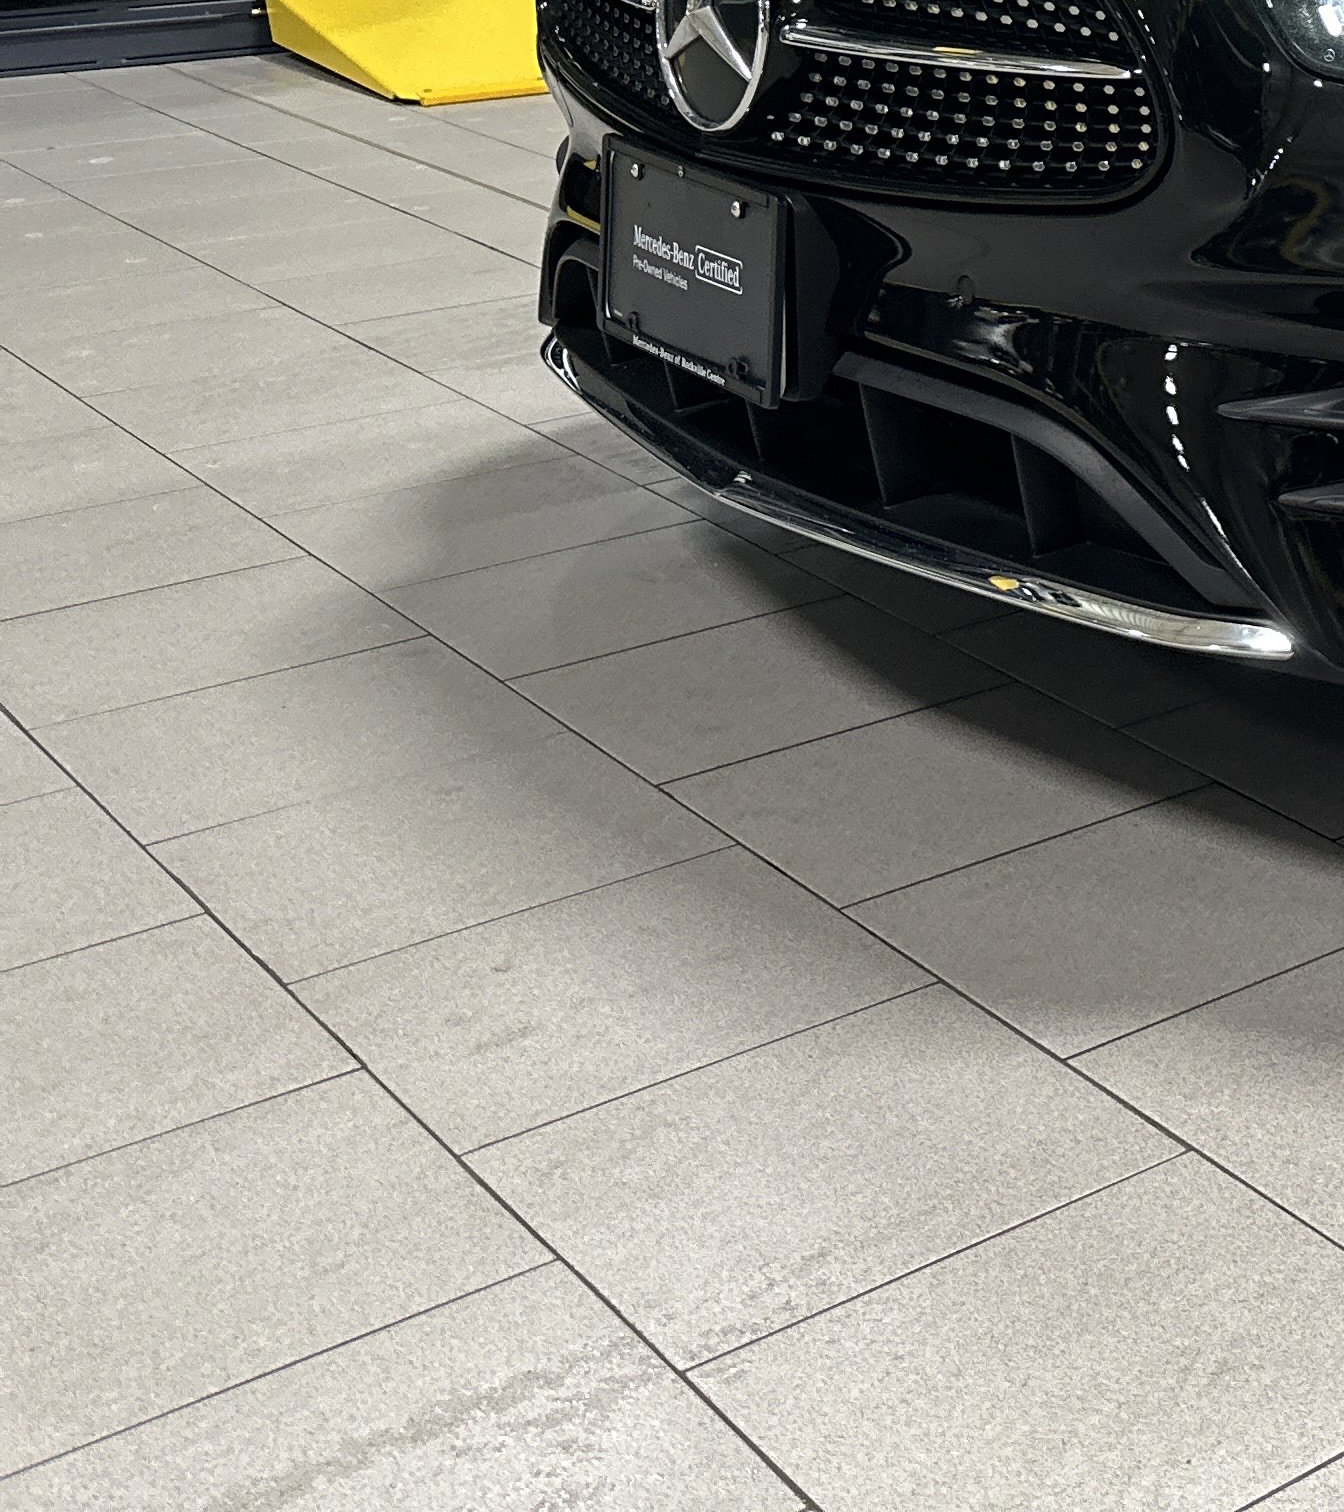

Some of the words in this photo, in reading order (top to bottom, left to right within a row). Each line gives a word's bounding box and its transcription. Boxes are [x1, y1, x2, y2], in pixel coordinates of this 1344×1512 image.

[632, 224, 695, 271] Mercedes-Benz
[697, 252, 740, 288] Certified
[632, 253, 663, 280] Pre-Owned
[662, 267, 688, 291] Vehicles
[632, 334, 675, 363] Mercedes-Benz
[674, 354, 681, 366] of
[681, 356, 707, 378] Rockville
